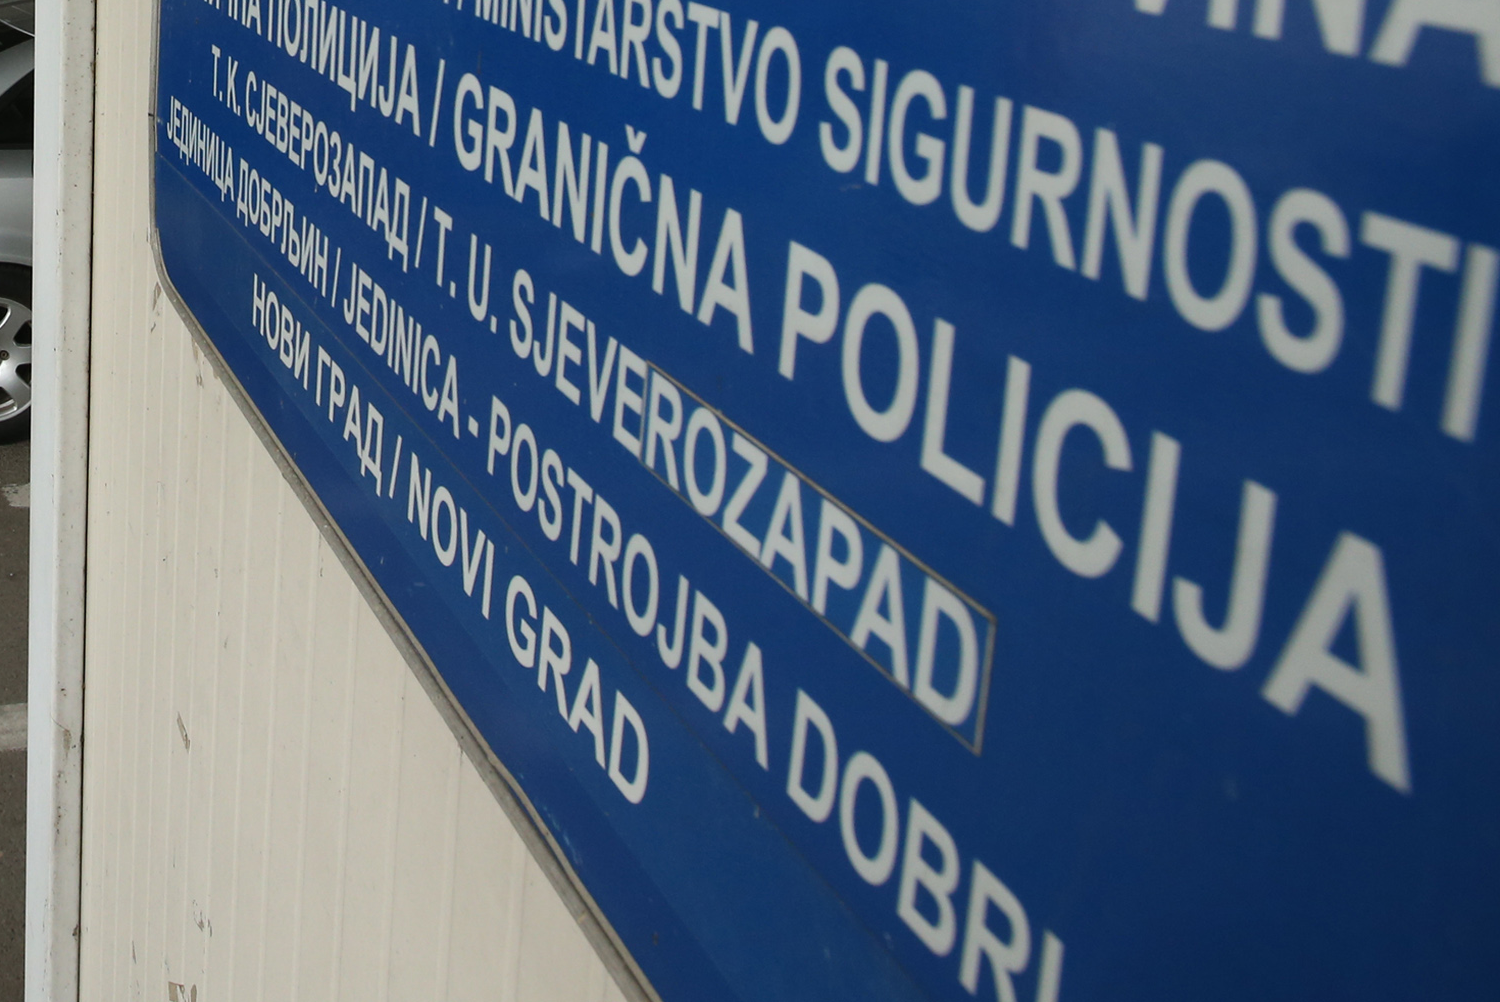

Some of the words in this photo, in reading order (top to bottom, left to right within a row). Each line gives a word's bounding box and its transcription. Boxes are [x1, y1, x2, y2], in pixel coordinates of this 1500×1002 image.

[167, 96, 235, 201] ЈЕДИНИЦА
[237, 158, 328, 297] ДОБРЉИН
[332, 248, 341, 307] /
[344, 263, 459, 439] JEDINICA
[487, 396, 768, 769] POSTROJBA
[246, 71, 410, 273] СЈЕВЕРОЗАПАД
[415, 197, 427, 268] /
[434, 207, 456, 298] T.
[468, 234, 497, 333] U.
[510, 269, 979, 726] SJEVEROZAPAD
[253, 274, 310, 390] НОВИ
[316, 346, 383, 497] ГРАД
[389, 435, 402, 499] /
[408, 452, 494, 619] NOVI
[506, 575, 649, 804] GRAD
[429, 59, 445, 147] /
[454, 73, 753, 354] GRANIČNA
[779, 241, 1408, 788] POLICIJA
[820, 47, 1498, 439] SIGURNOSTI
